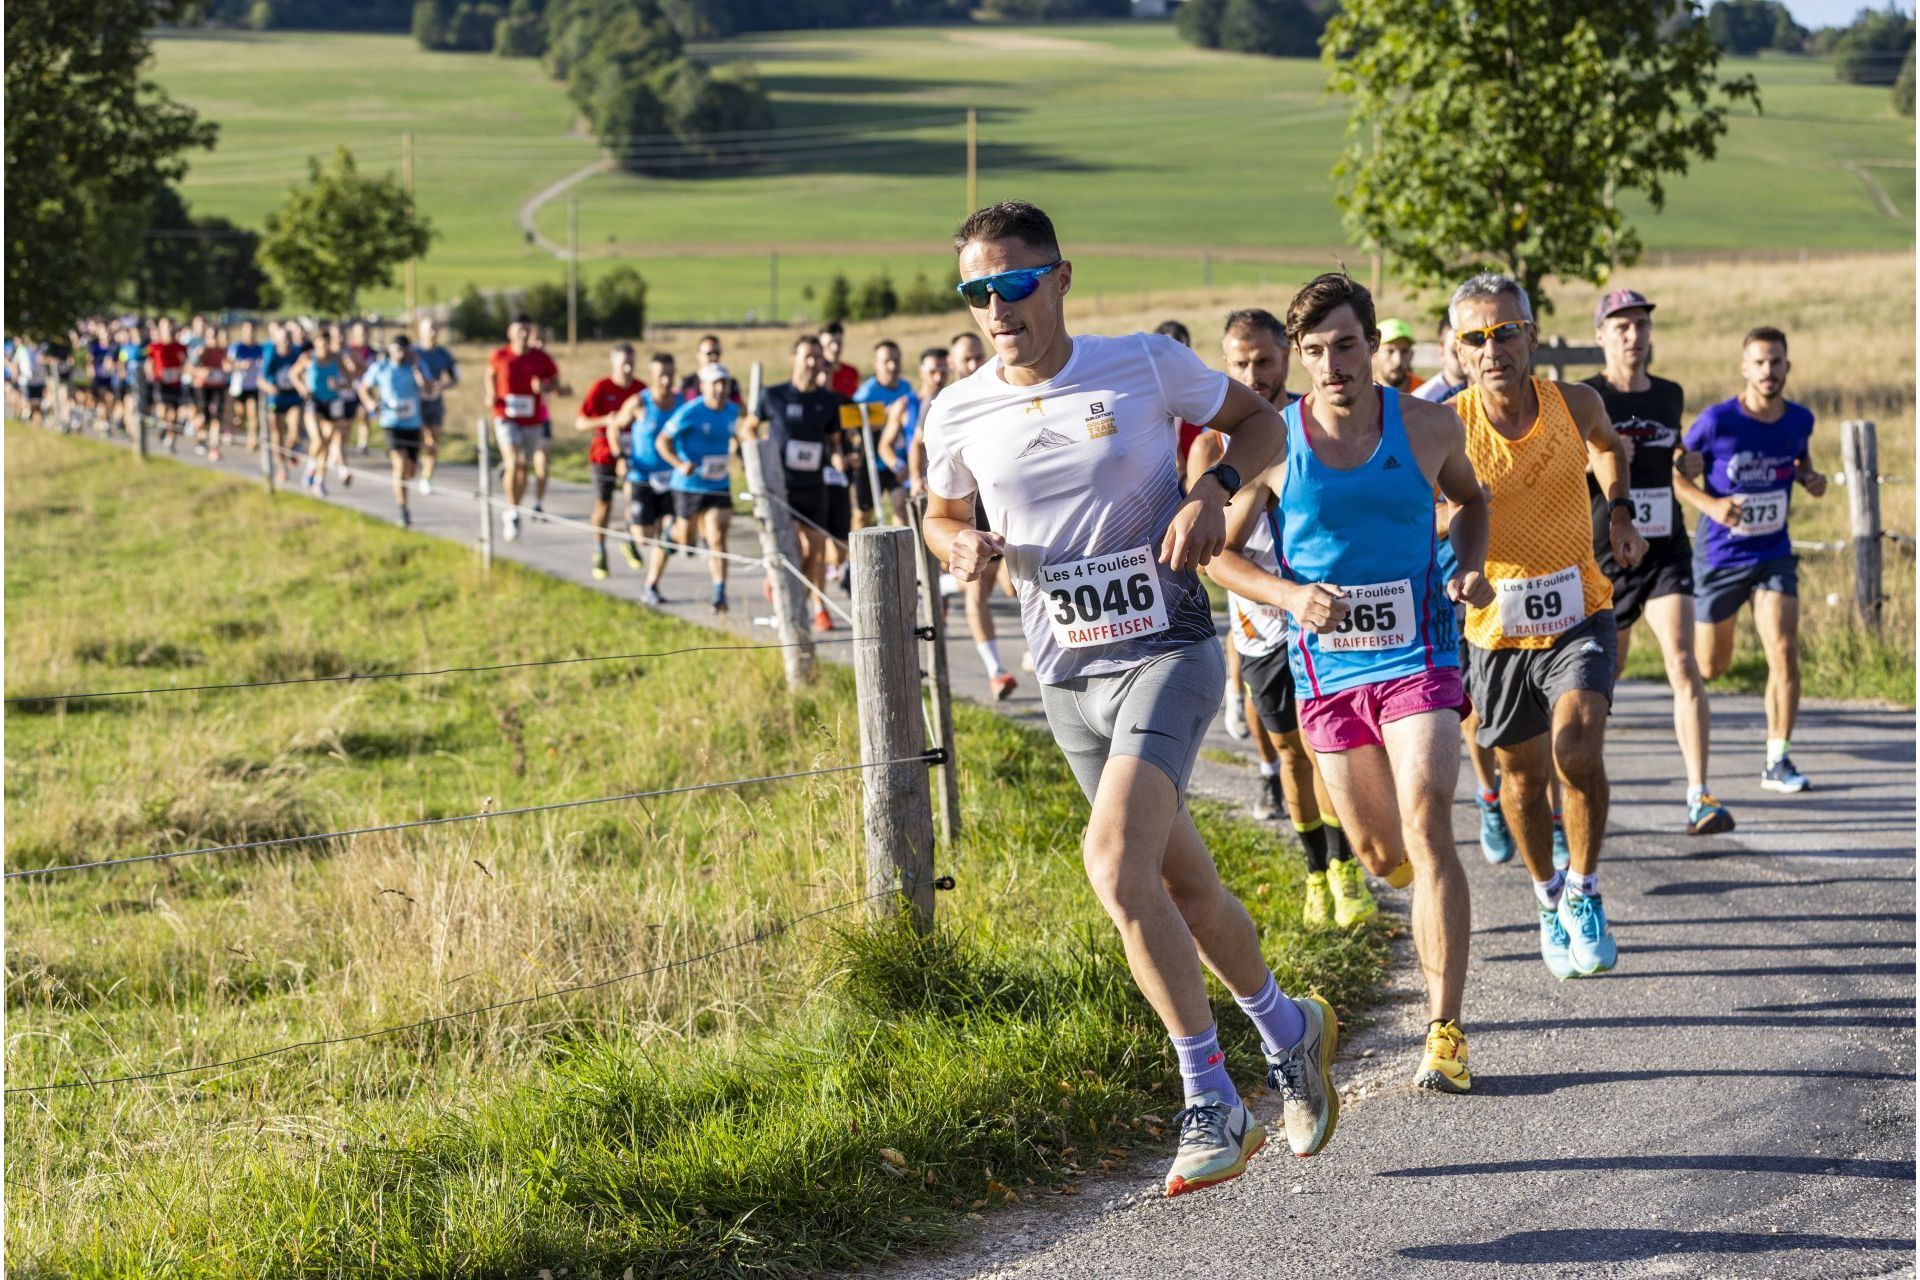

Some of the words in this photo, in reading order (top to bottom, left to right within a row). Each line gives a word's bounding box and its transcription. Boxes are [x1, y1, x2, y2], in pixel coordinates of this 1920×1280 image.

[1085, 411, 1114, 422] salomon
[1088, 423, 1117, 434] TRAIL
[1523, 432, 1562, 488] CRAFT
[1743, 504, 1777, 523] 373
[1044, 570, 1070, 582] Les
[1074, 565, 1083, 577] 4
[1087, 553, 1147, 575] Foulées
[1356, 585, 1405, 598] Foulées
[1503, 584, 1523, 592] Les
[1526, 581, 1533, 590] 4
[1536, 571, 1576, 589] Foulées
[1050, 573, 1155, 625] 3046
[1525, 591, 1562, 620] 69
[1068, 616, 1154, 643] RAIFFEISEN
[1515, 615, 1576, 634] RAIFFEISEN
[1333, 633, 1405, 648] RAIFFEISEN
